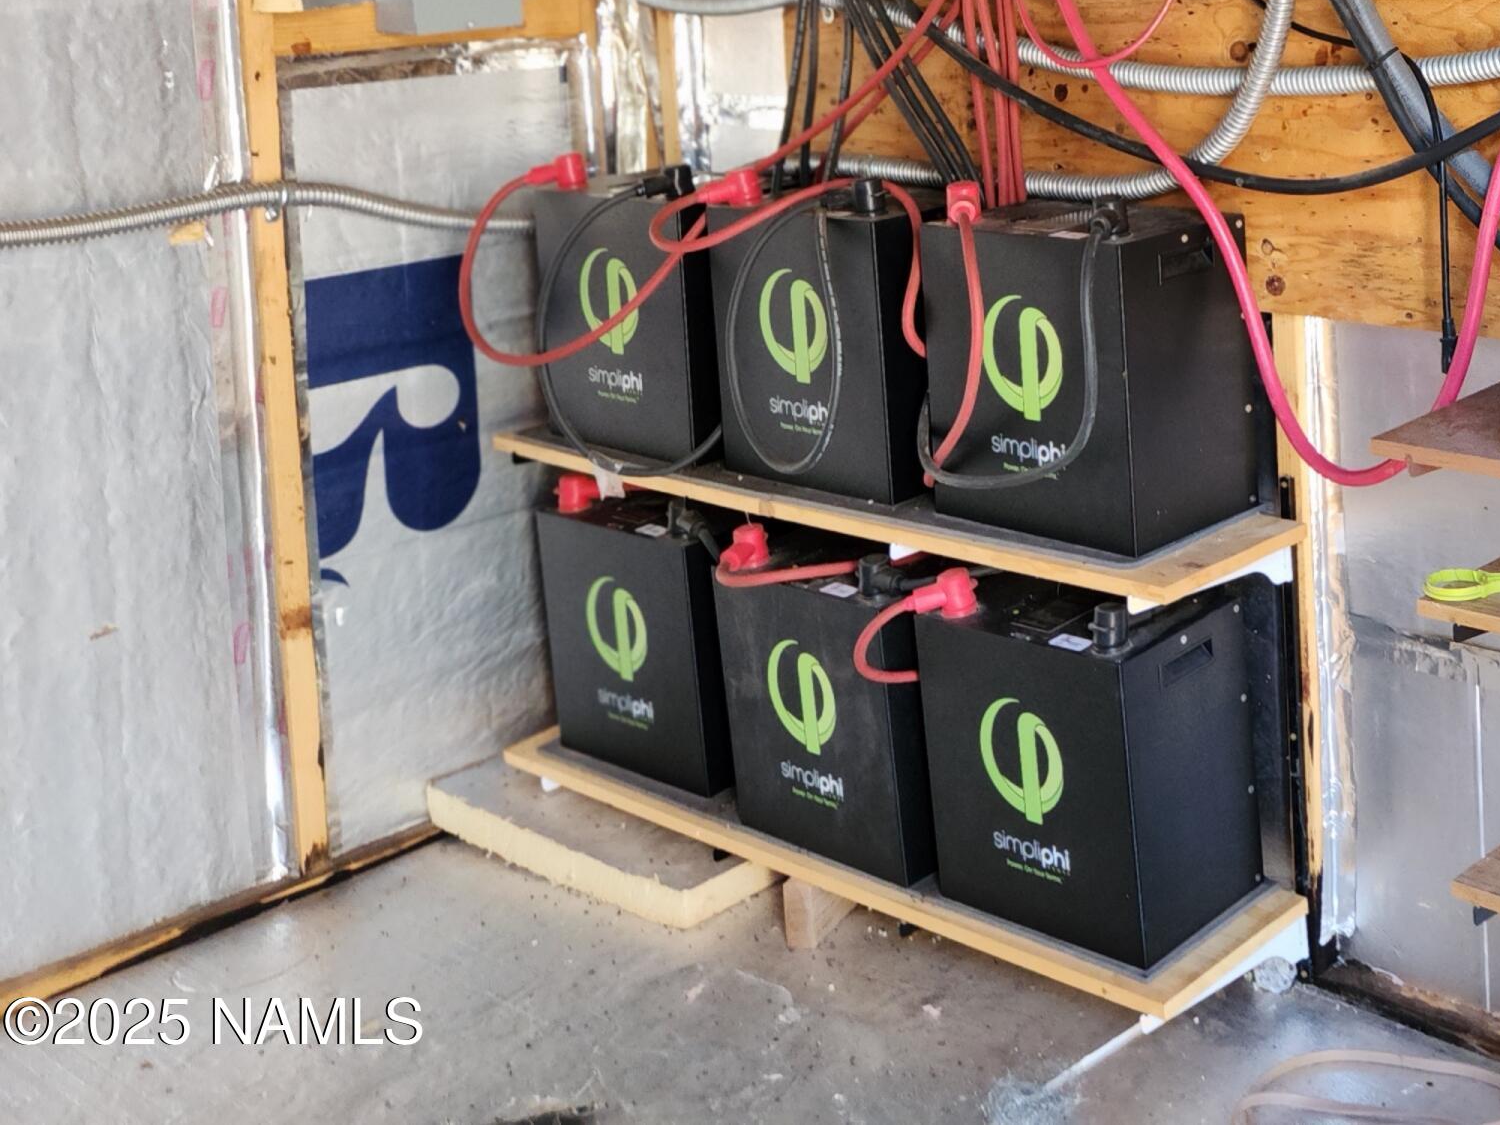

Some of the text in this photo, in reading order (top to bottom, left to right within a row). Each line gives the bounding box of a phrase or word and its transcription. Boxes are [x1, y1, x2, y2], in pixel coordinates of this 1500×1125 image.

[588, 365, 642, 394] simpliphi
[769, 395, 829, 425] simpliph
[781, 760, 844, 801] simpliphi
[993, 830, 1071, 875] simpliphi
